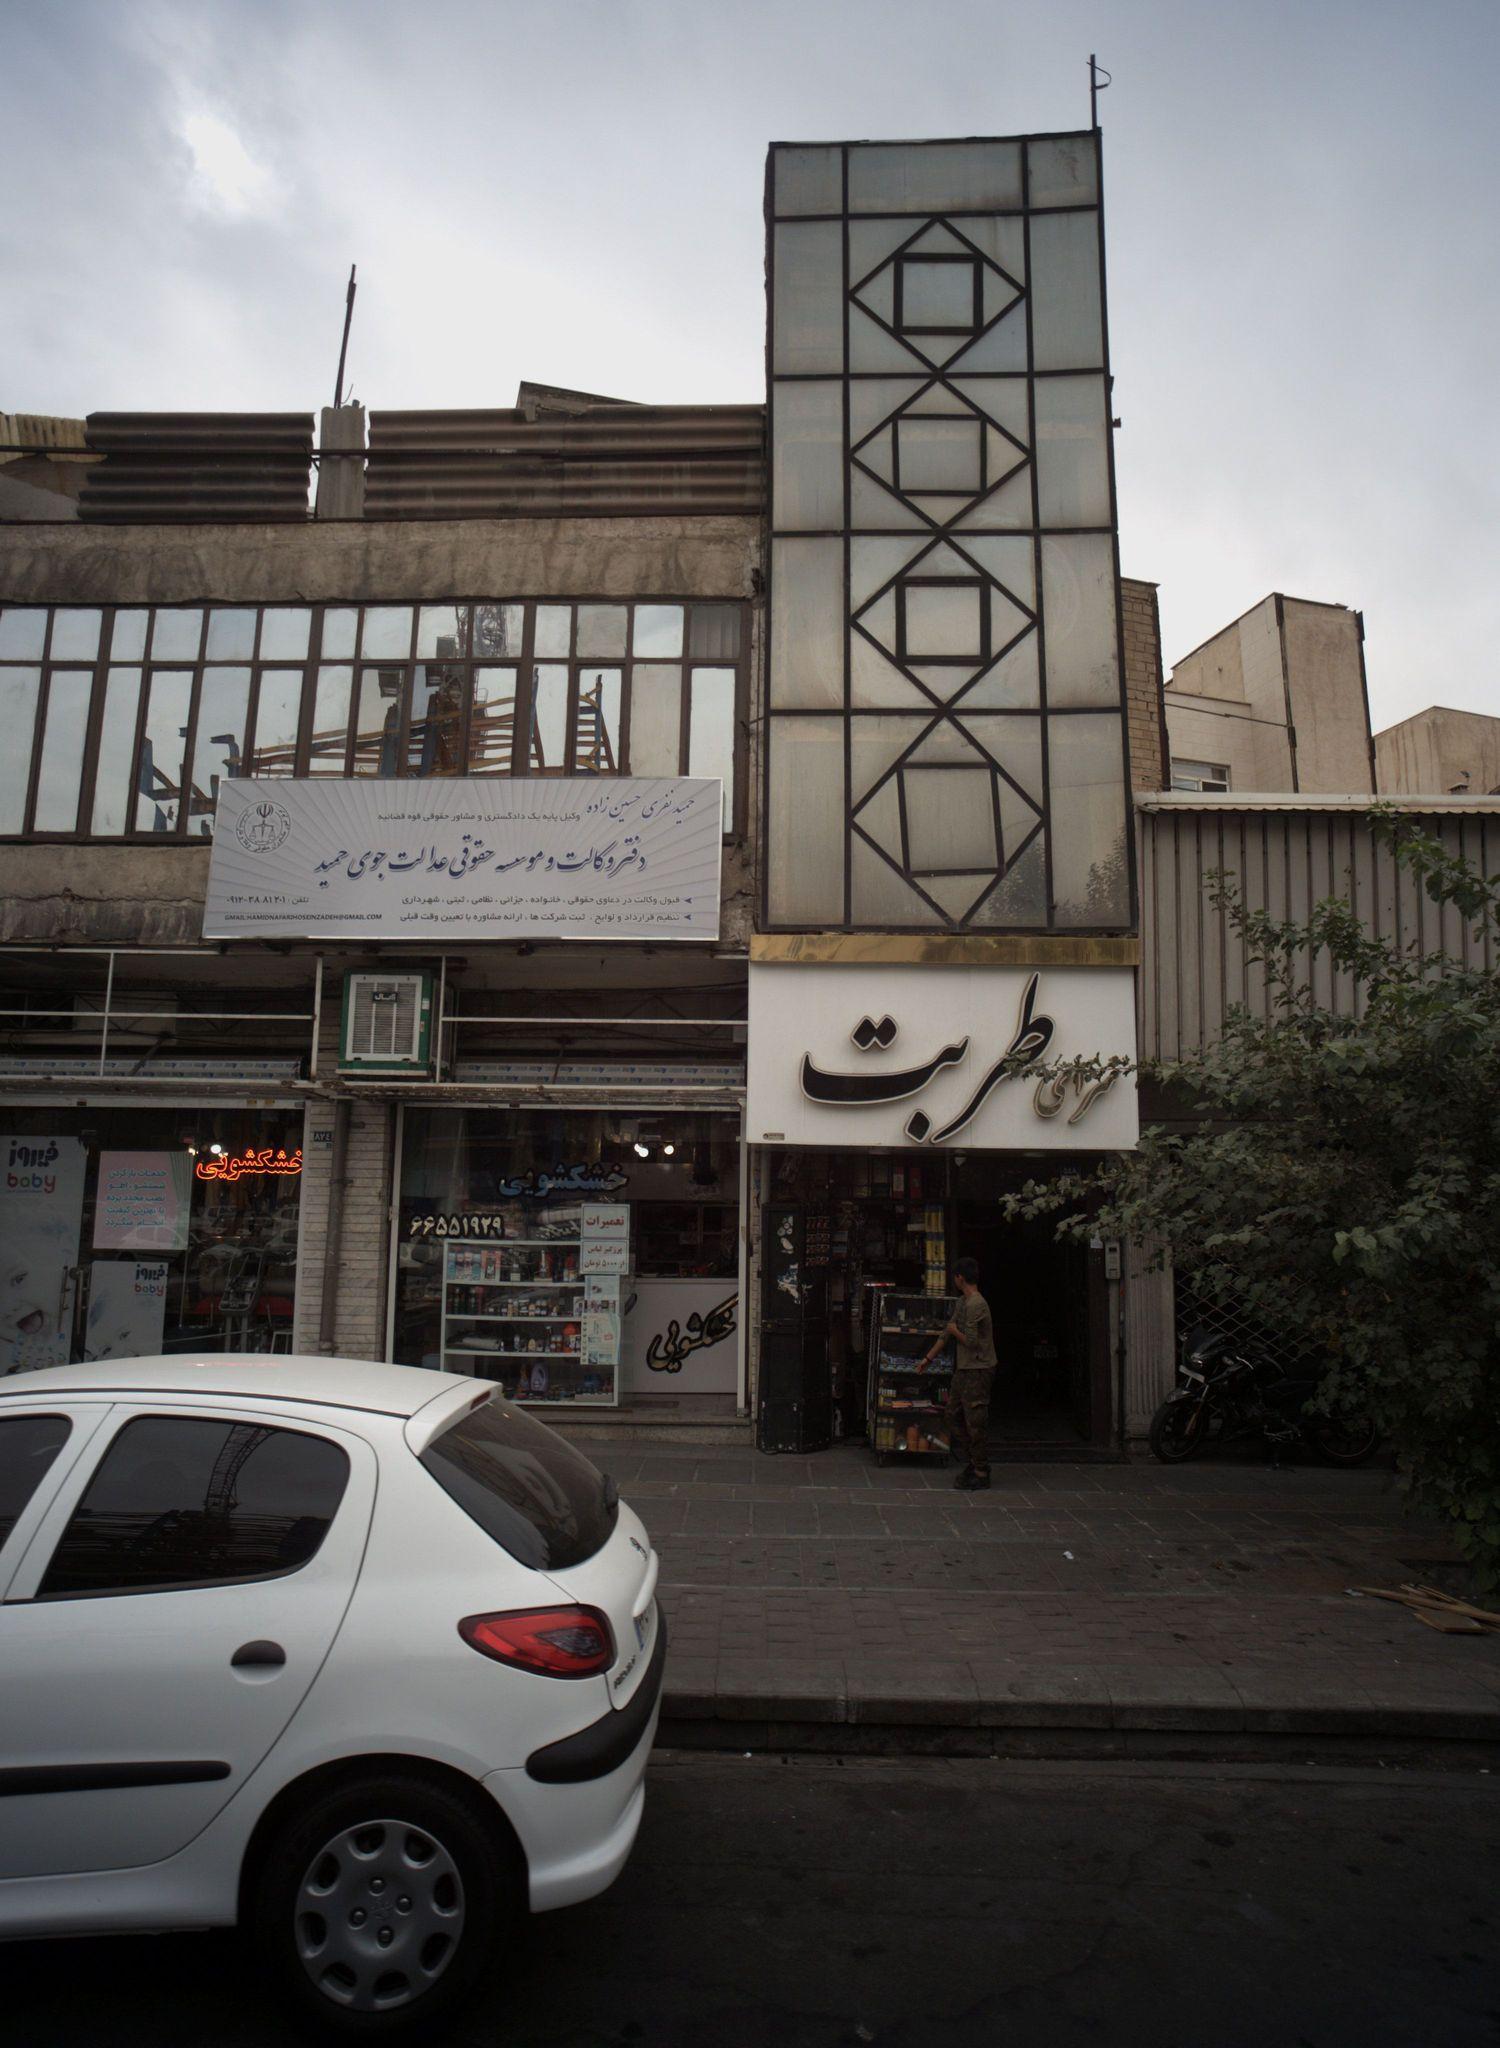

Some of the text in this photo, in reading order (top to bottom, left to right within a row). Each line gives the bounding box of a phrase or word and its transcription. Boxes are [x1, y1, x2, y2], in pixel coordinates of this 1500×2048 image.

[586, 796, 609, 813] زاده
[609, 795, 641, 822] حسین
[485, 811, 526, 822] دادگستری
[672, 799, 694, 824] حمید
[422, 812, 450, 823] حقوقی
[451, 812, 476, 823] مشاور
[528, 812, 541, 822] یک
[560, 812, 581, 822] وکیل
[314, 834, 647, 888] دفتر وکالت و موسسه حقوقی عدالت جوی حمید
[401, 895, 440, 905] شهرداری
[596, 896, 620, 905] دعاوی
[622, 897, 632, 905] در
[634, 896, 658, 905] وکالت
[659, 896, 680, 906] قبول
[420, 912, 439, 922] وقت
[473, 911, 502, 922] مشاوره
[541, 912, 567, 922] شرکت
[568, 913, 586, 922] ثبت
[625, 913, 655, 922] قرارداد
[656, 913, 680, 923] تنظیم
[9, 1139, 59, 1167] فیروز
[7, 1172, 56, 1194] baby
[585, 1215, 625, 1229] تعمیرات
[584, 1259, 600, 1268] تومان
[135, 1283, 164, 1296] baby
